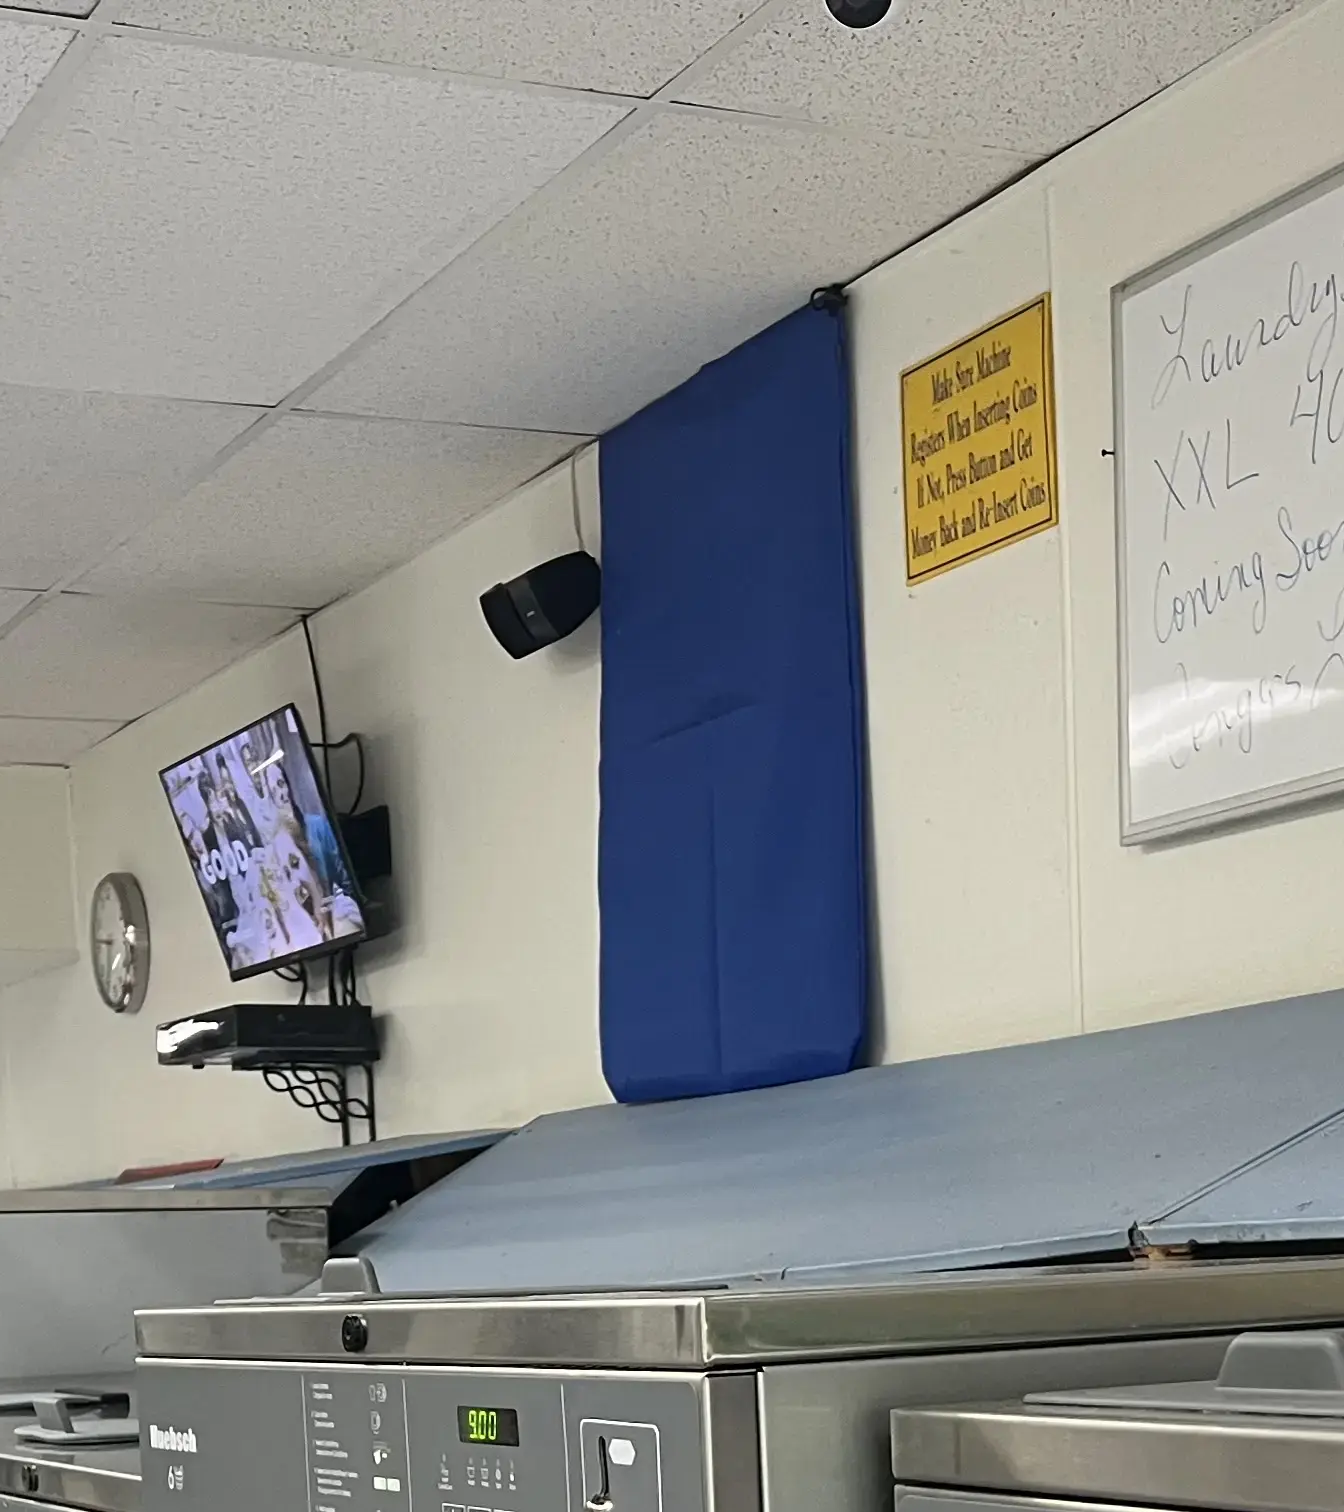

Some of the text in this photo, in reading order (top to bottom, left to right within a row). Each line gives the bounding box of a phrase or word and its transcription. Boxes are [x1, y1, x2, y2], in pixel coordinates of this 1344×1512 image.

[976, 341, 1011, 383] Machine
[1152, 262, 1342, 408] Laundry
[911, 377, 1037, 467] Registers When Inserting Coins
[945, 464, 966, 495] Press
[968, 451, 996, 484] Button
[1000, 433, 1014, 470] and
[1017, 428, 1033, 461] Get
[911, 526, 937, 560] Money
[939, 511, 958, 547] Back
[961, 507, 976, 538] and
[1020, 476, 1047, 511] Coins
[1155, 418, 1259, 541] XXL
[1154, 551, 1266, 643] Coming
